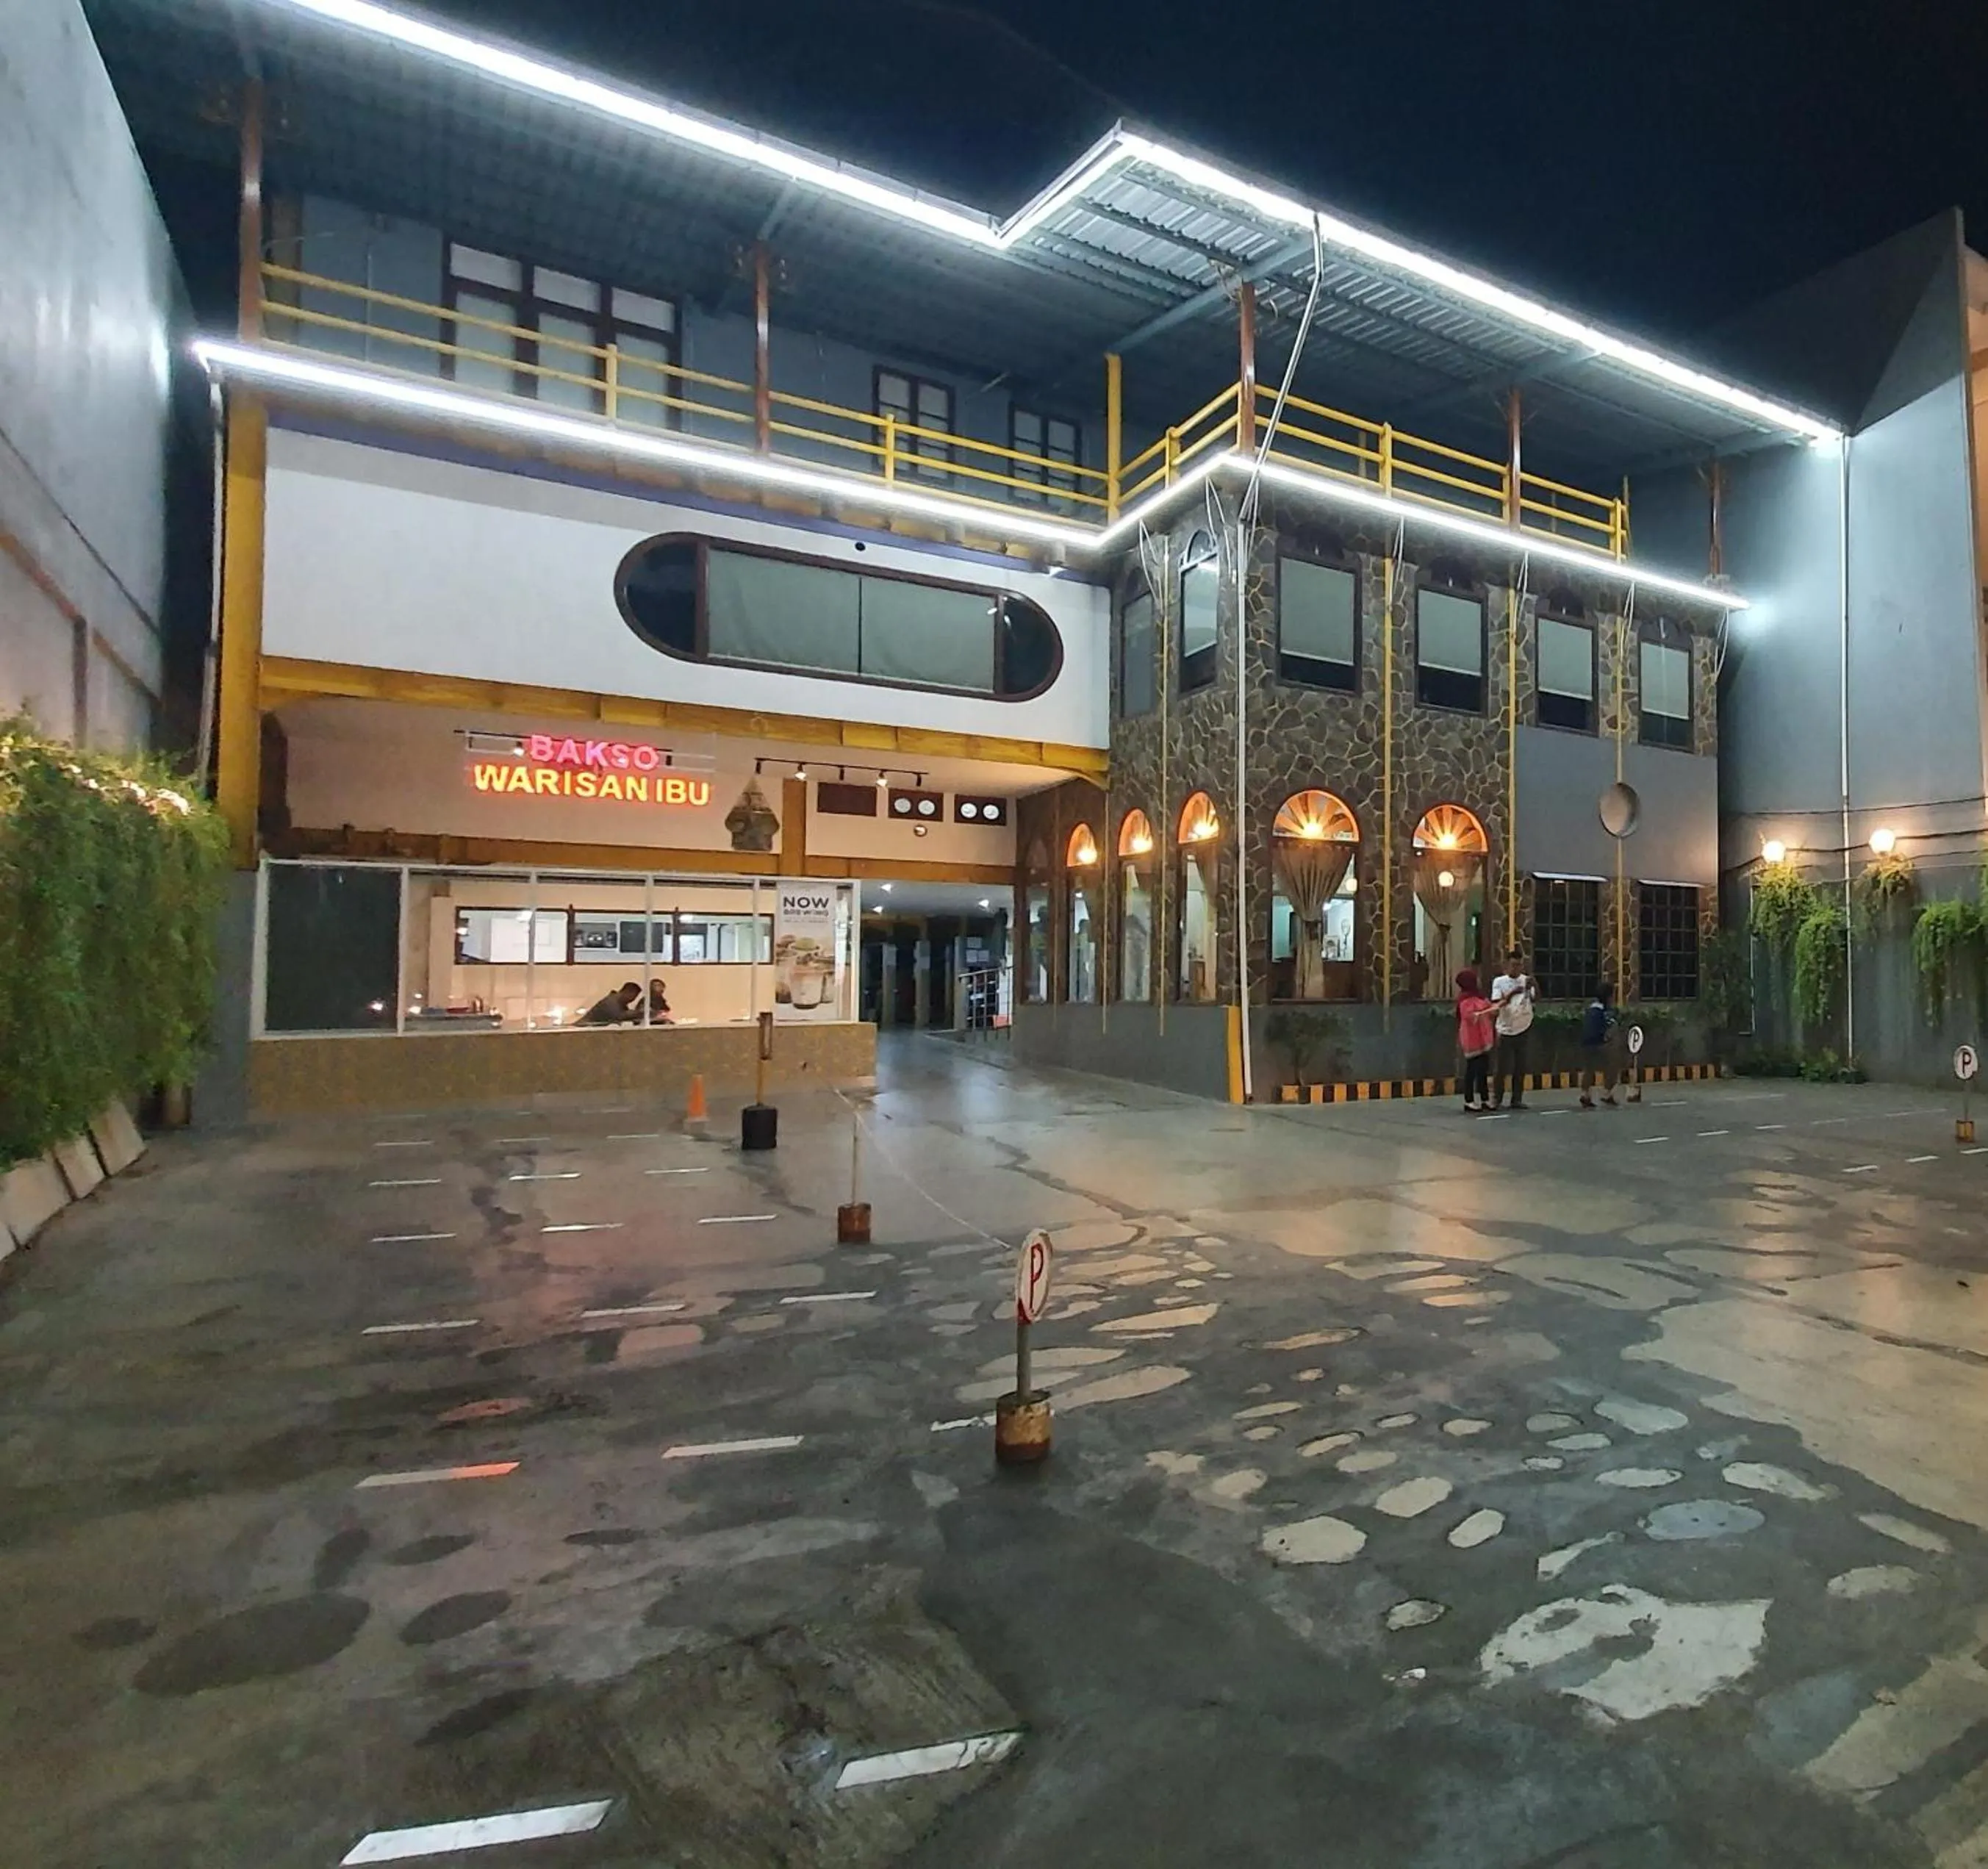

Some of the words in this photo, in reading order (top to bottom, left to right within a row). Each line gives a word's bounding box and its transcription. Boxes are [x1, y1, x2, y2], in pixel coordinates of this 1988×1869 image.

[530, 734, 659, 770] BAKSO
[474, 764, 647, 803] WARISAN
[656, 779, 710, 806] IBU
[783, 896, 829, 908] NOW
[1962, 1052, 1971, 1075] P
[1030, 1243, 1044, 1312] P
